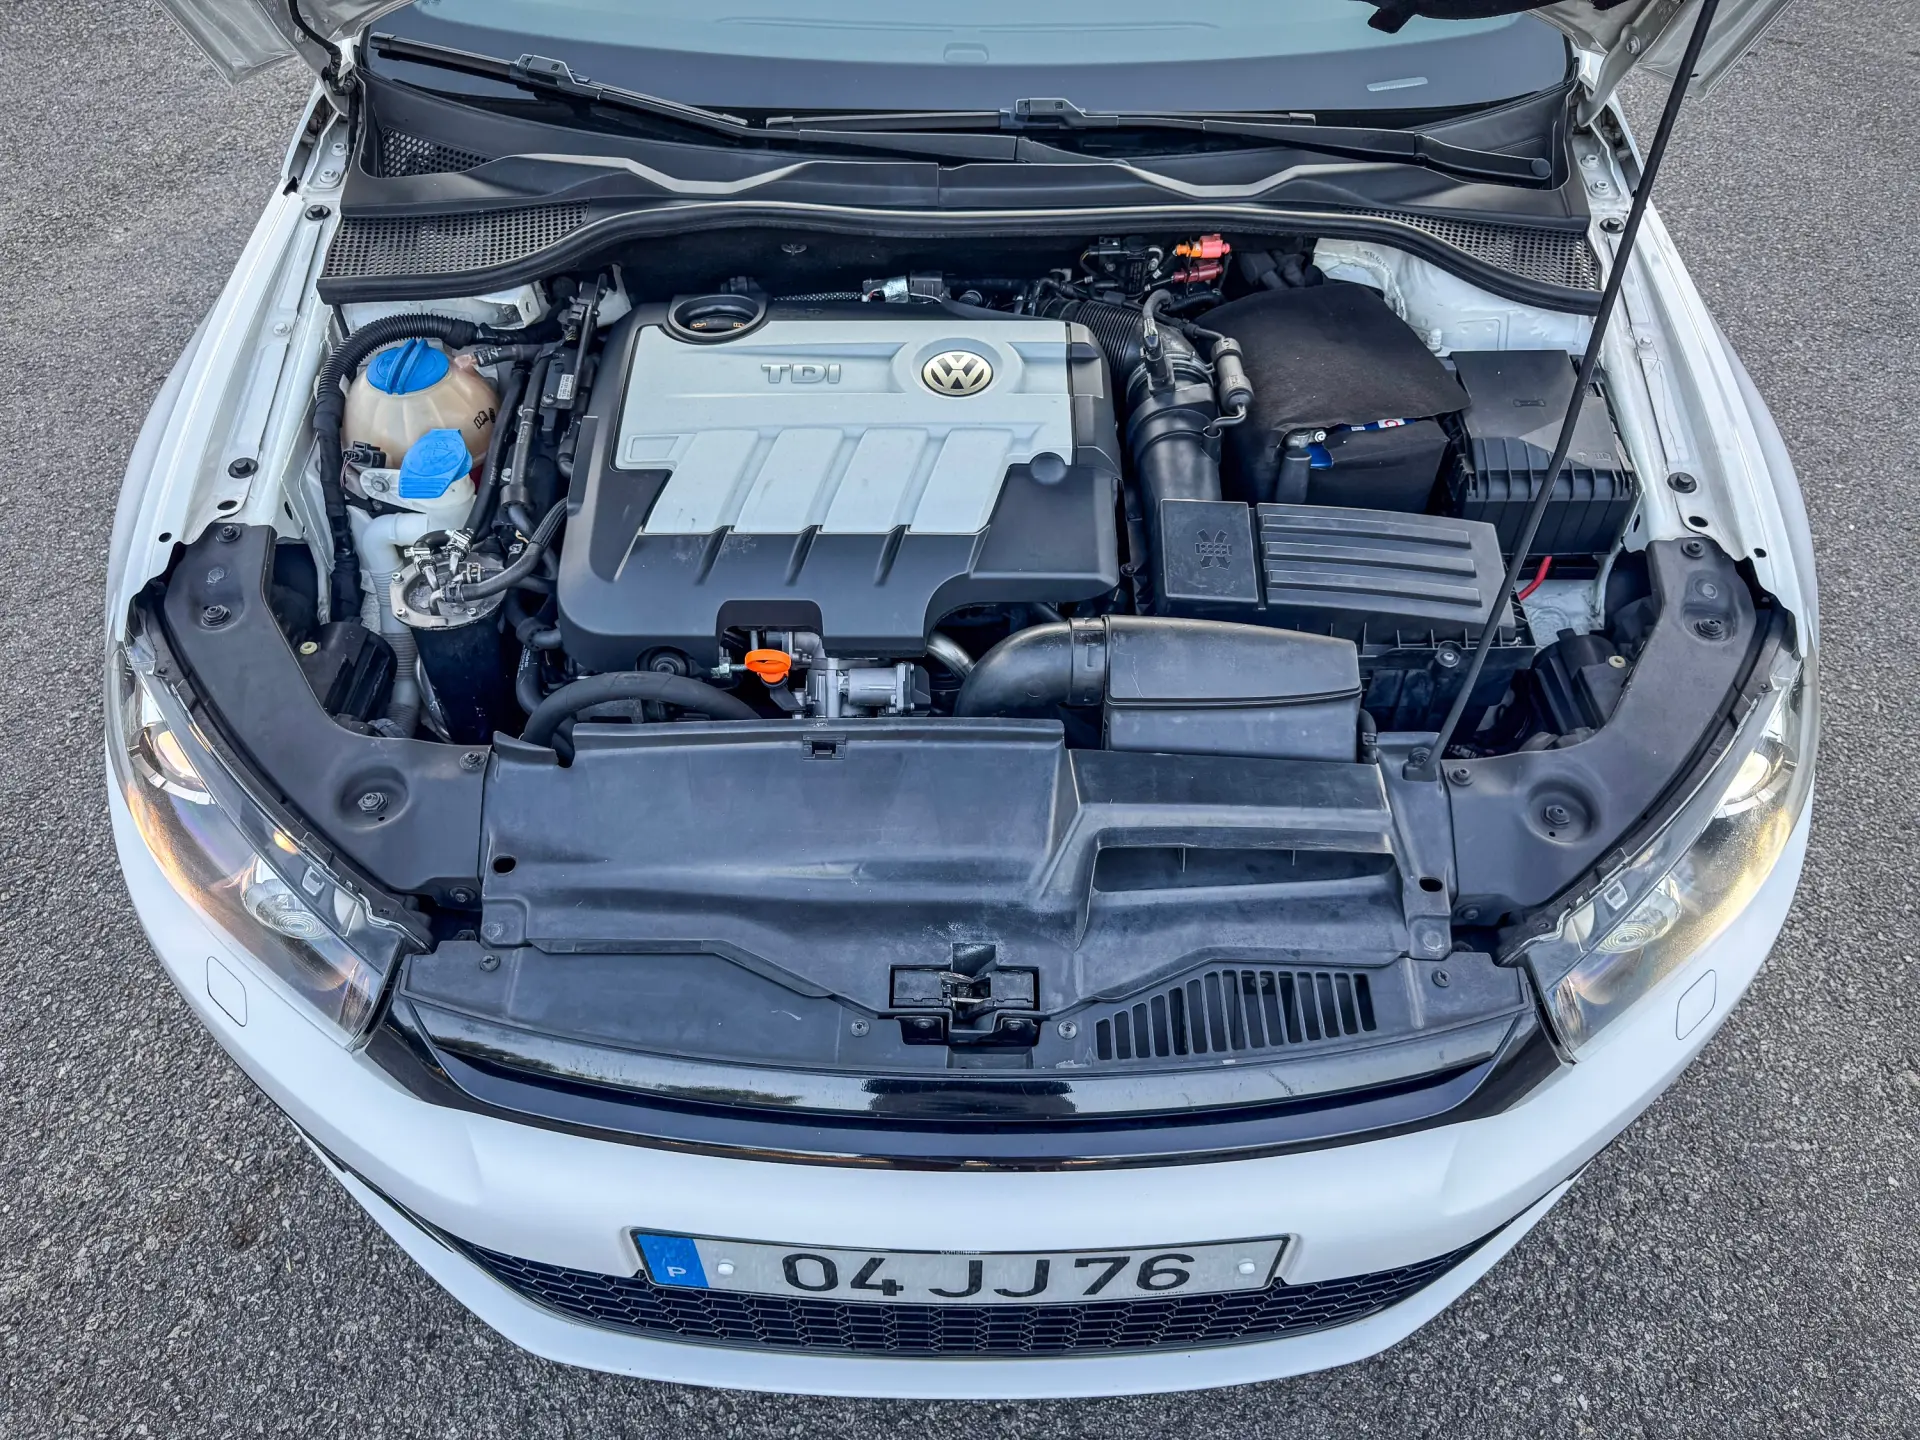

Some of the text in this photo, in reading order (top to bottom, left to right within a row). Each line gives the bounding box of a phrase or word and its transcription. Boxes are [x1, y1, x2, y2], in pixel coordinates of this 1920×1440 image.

[761, 364, 841, 384] TDI
[667, 1266, 687, 1278] P
[782, 1253, 1195, 1297] 04 JJ 76
